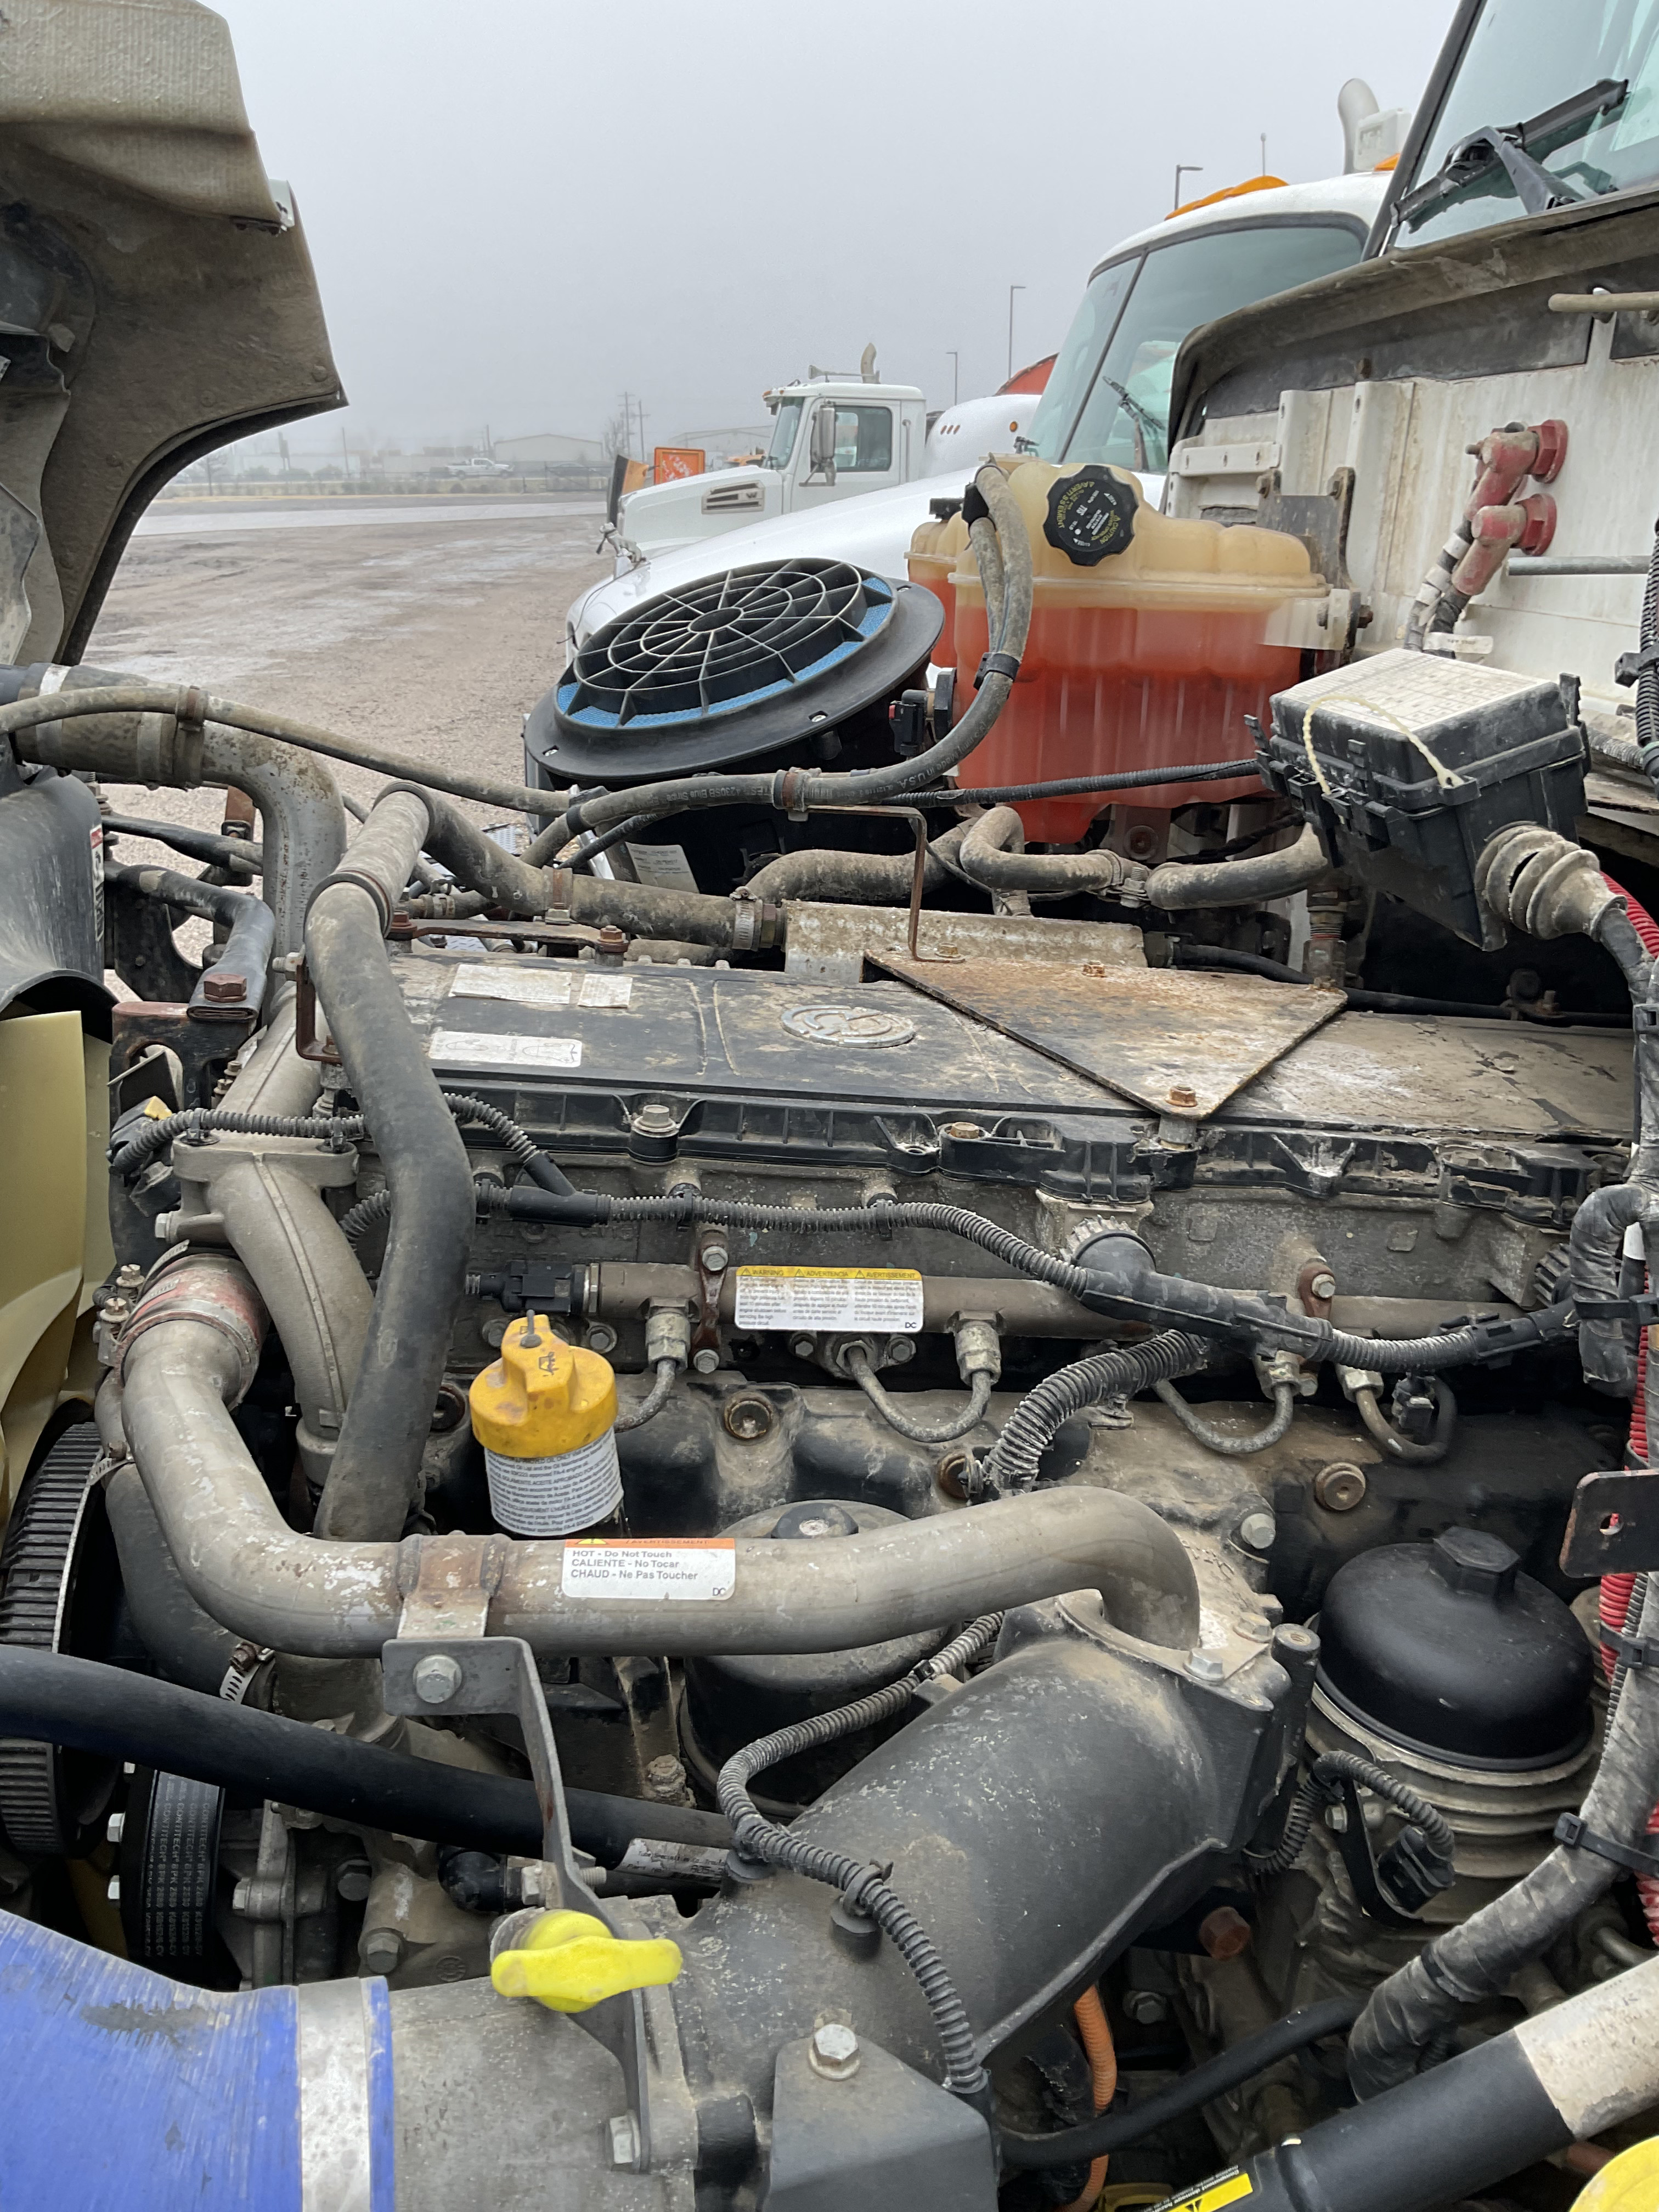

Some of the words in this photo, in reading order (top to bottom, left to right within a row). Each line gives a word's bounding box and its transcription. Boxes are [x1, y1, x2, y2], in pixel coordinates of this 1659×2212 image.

[936, 753, 959, 770] Made
[927, 768, 935, 776] in
[896, 773, 926, 789] U.S.A.
[689, 789, 708, 799] Blue
[751, 786, 772, 795] TES
[572, 1559, 625, 1568] CALIENTE
[635, 1560, 649, 1568] No
[650, 1560, 679, 1568] Tocar
[571, 1570, 610, 1578] CHAUD
[619, 1571, 633, 1579] Ne
[636, 1571, 654, 1579] Pas
[656, 1571, 698, 1580] Toucher
[713, 1588, 726, 1596] DC
